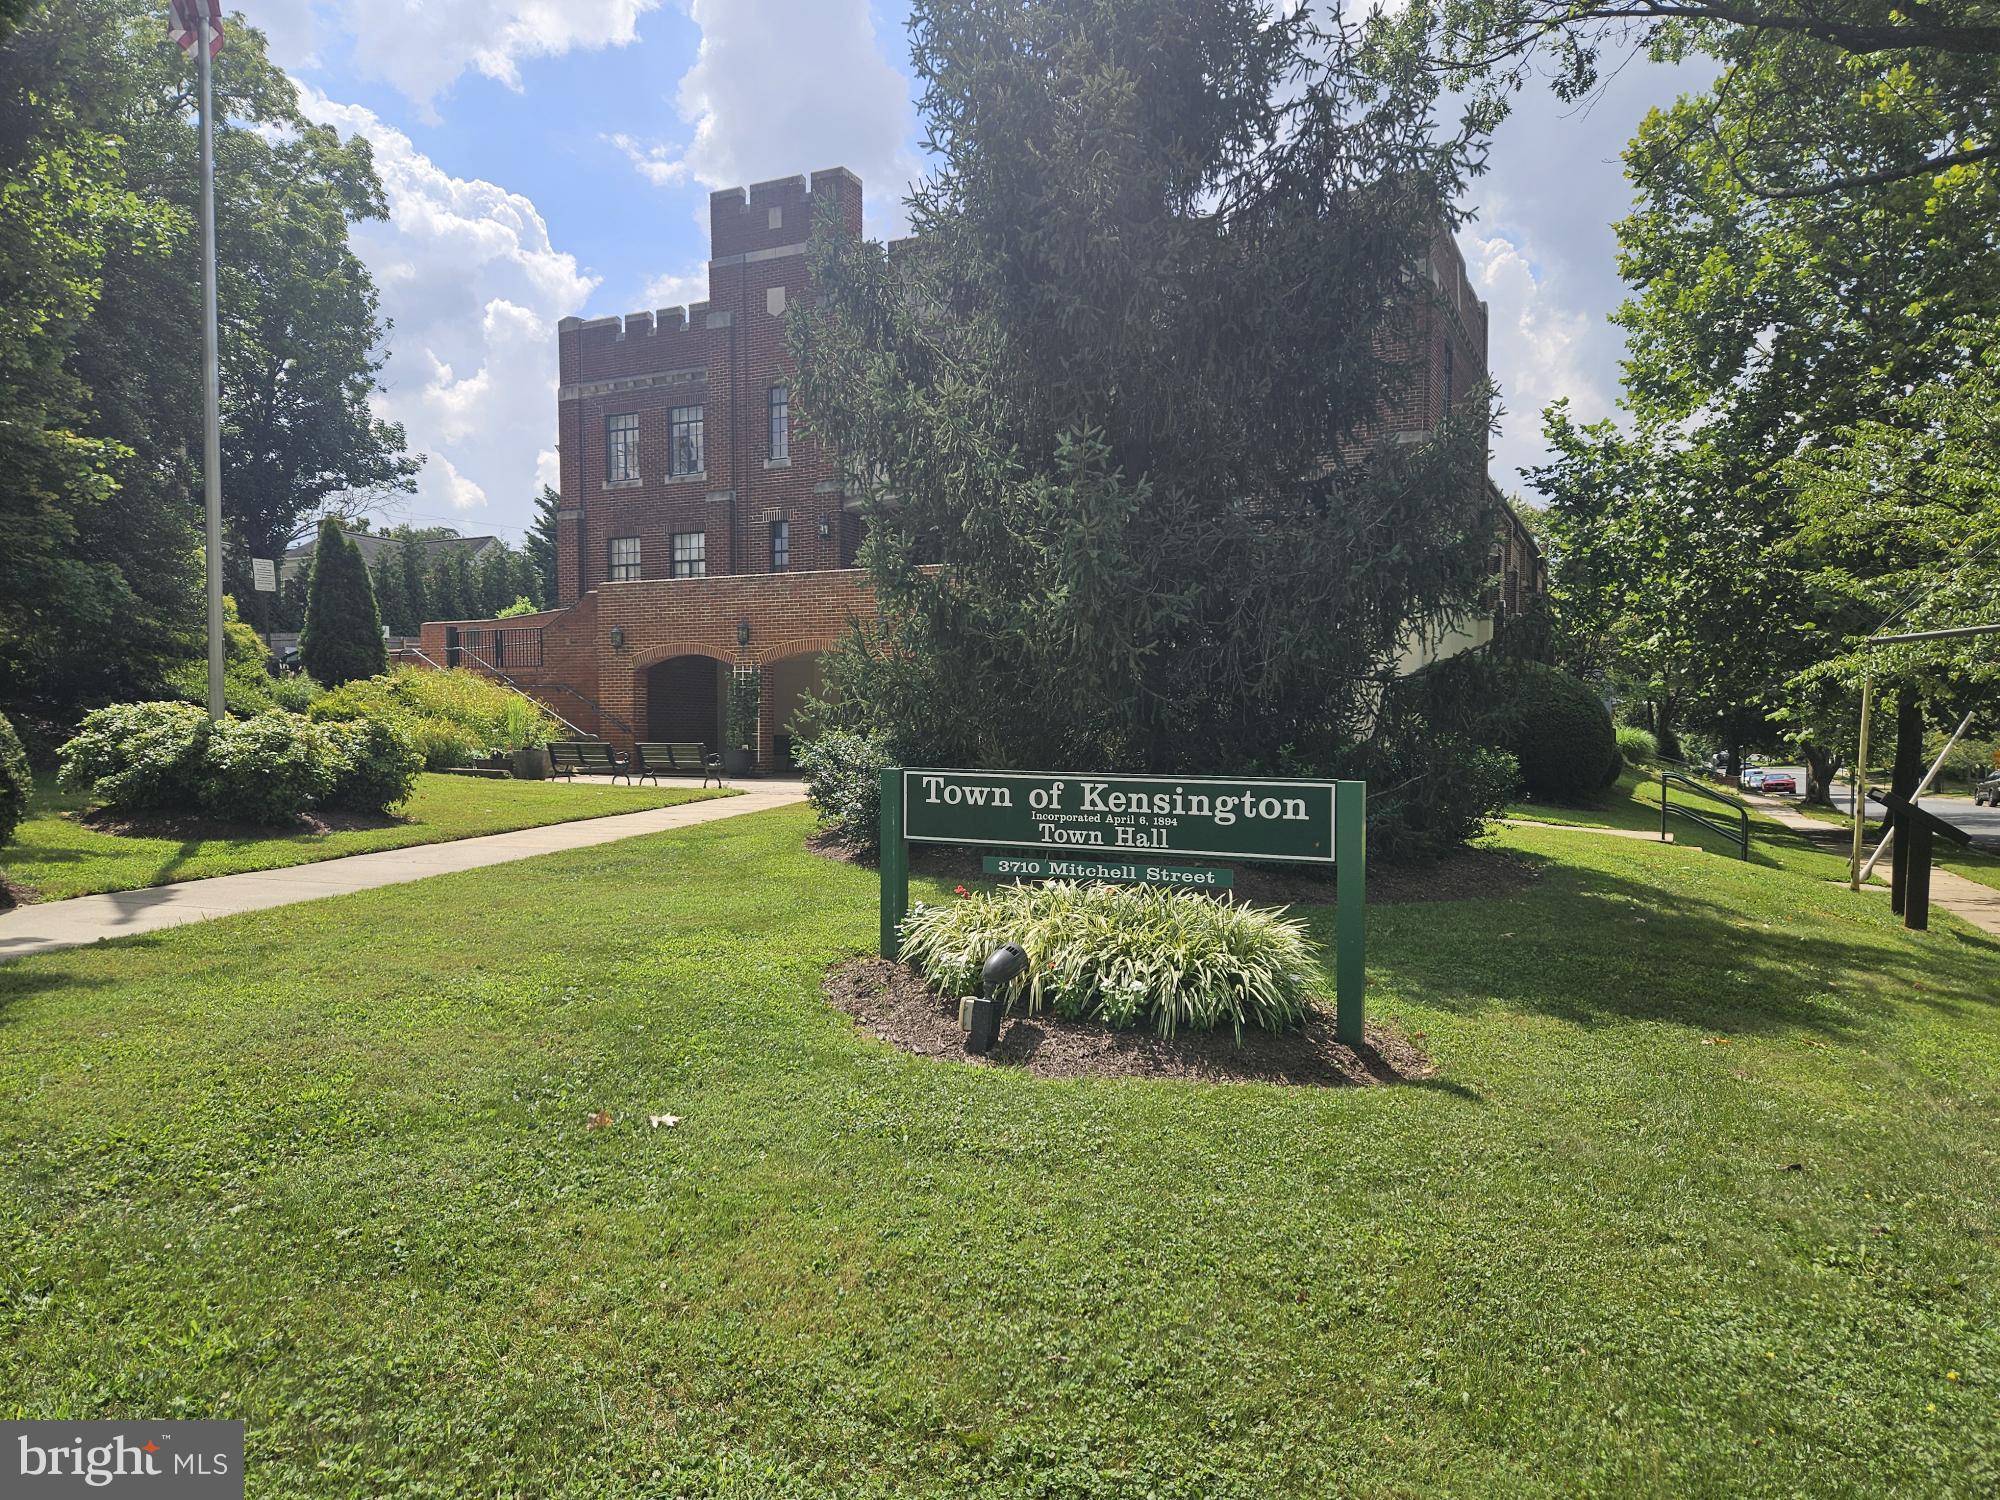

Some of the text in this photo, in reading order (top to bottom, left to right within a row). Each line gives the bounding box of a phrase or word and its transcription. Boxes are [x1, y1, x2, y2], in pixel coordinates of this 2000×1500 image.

[922, 776, 1310, 826] Town of Kensington
[1031, 810, 1178, 827] Incorporated April 6, 1894
[1038, 823, 1169, 849] Town Hall
[998, 860, 1215, 884] 3710 Mitchell Street
